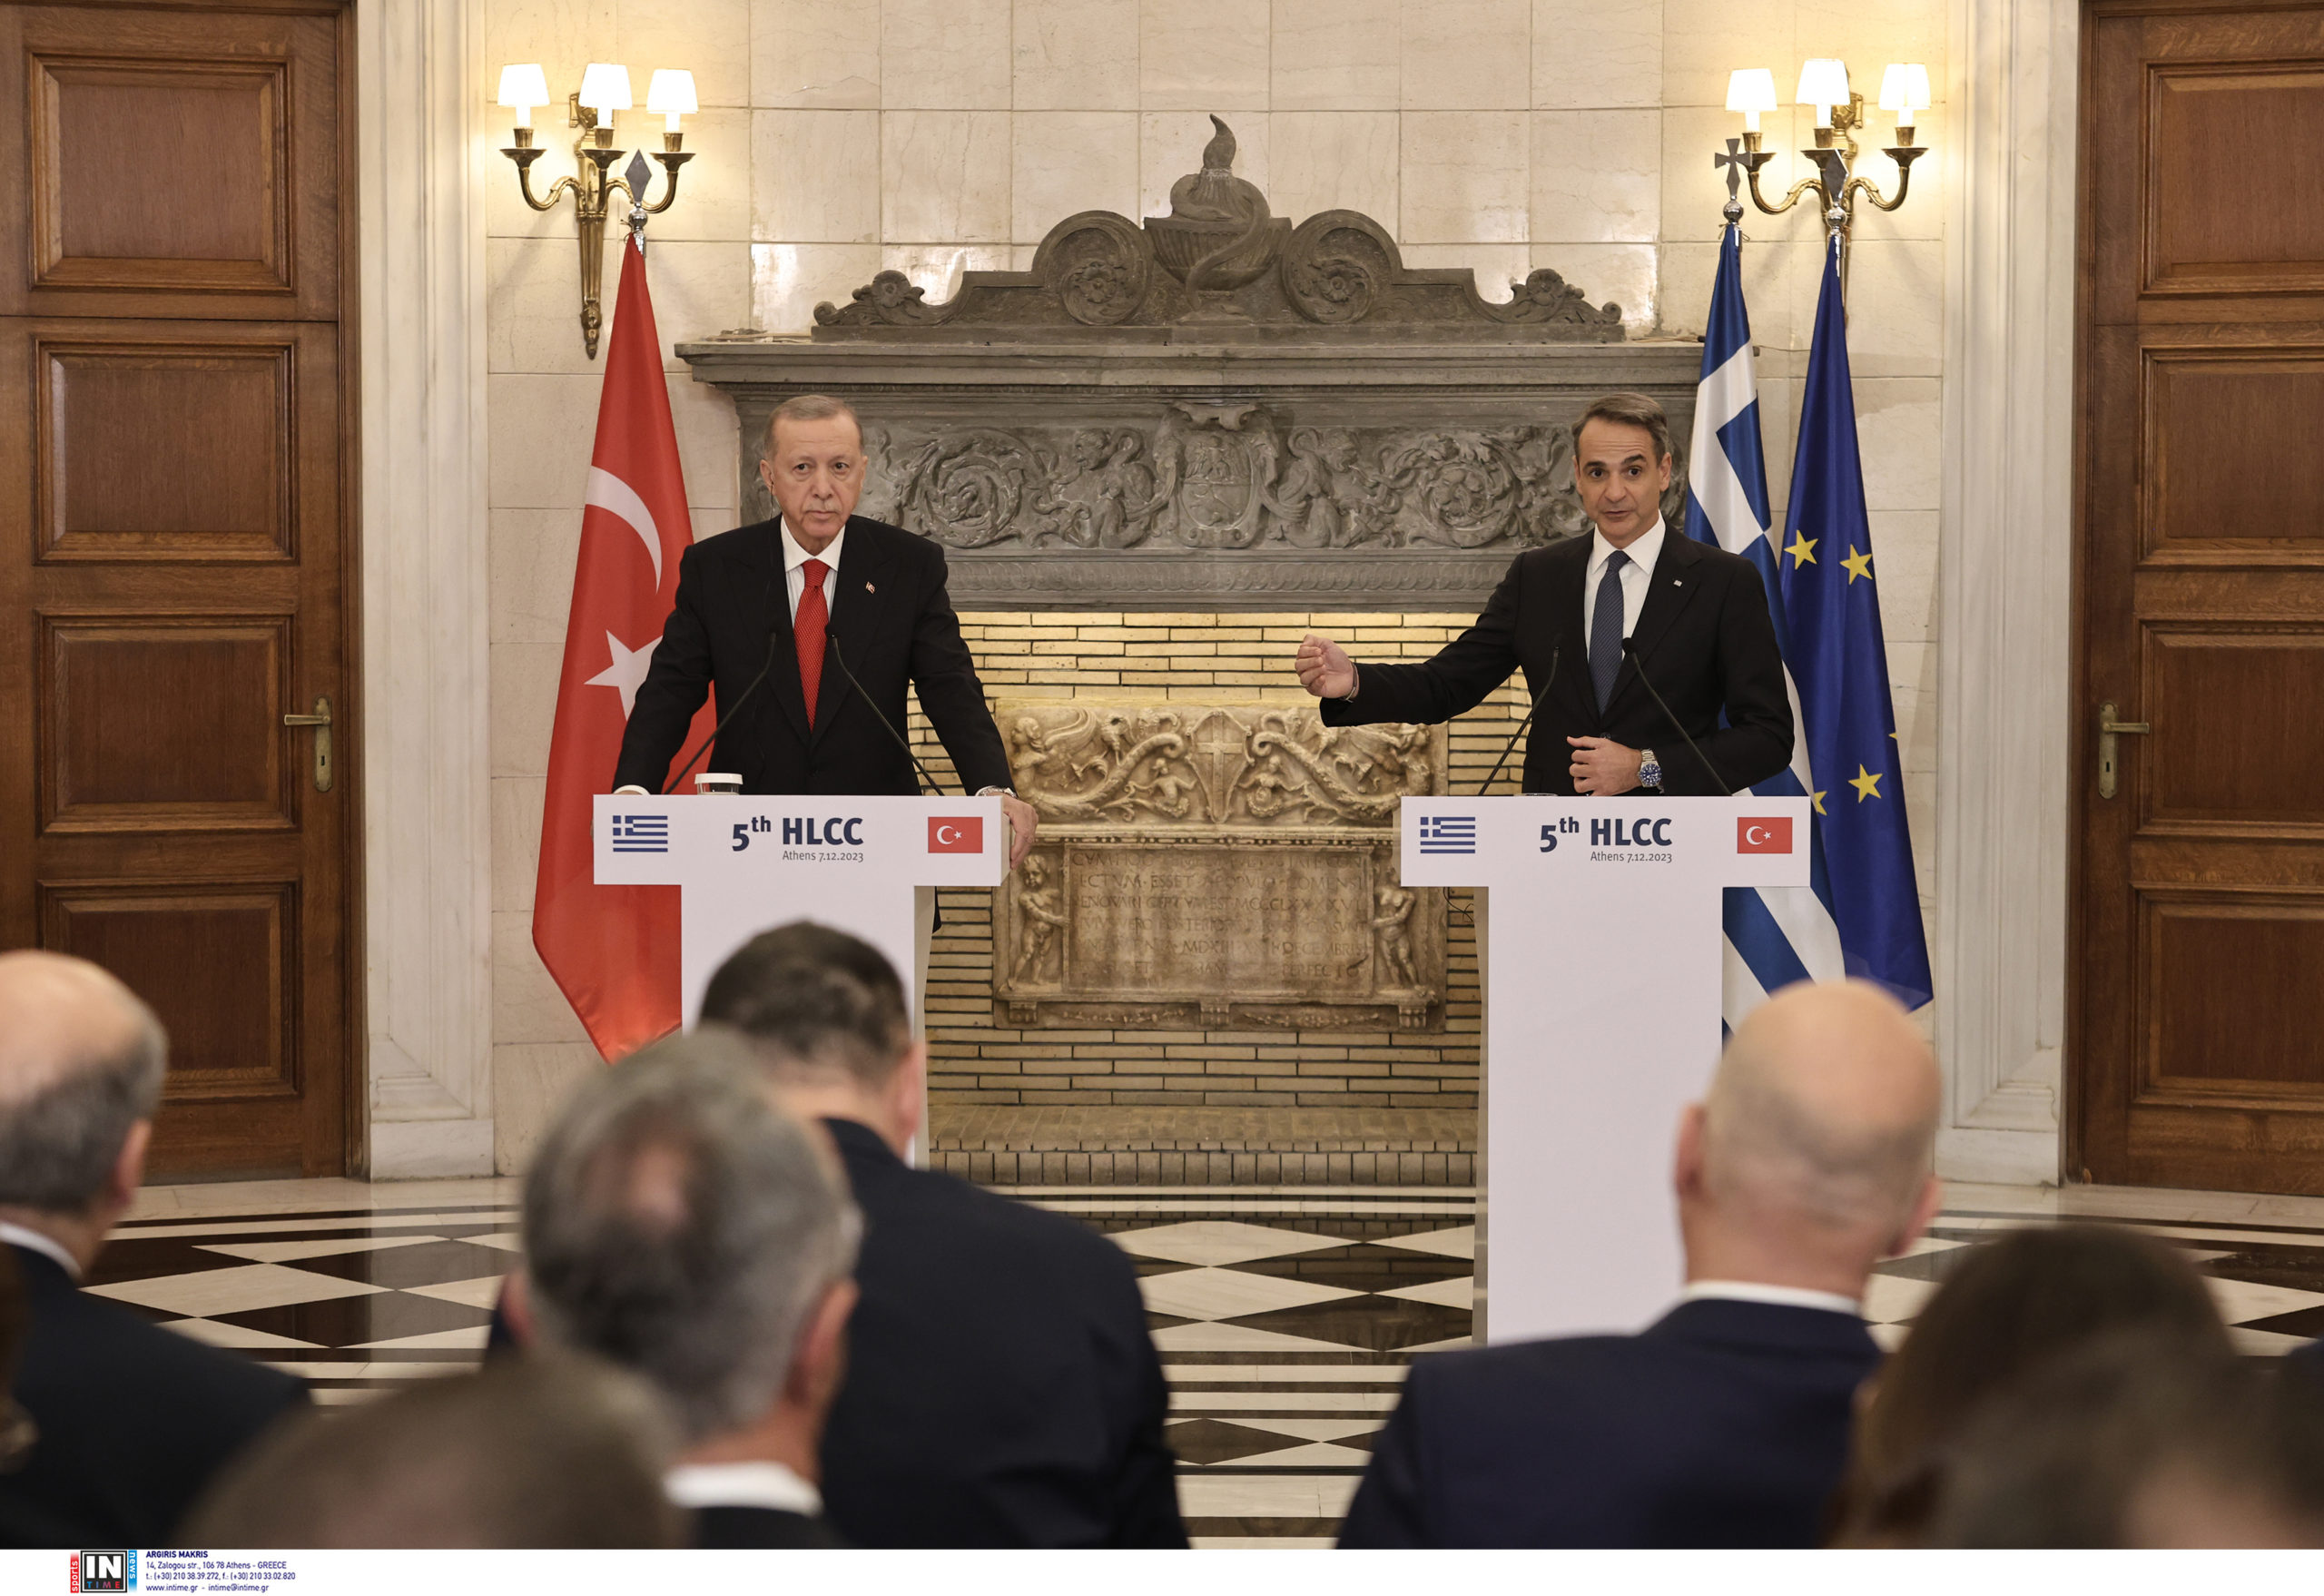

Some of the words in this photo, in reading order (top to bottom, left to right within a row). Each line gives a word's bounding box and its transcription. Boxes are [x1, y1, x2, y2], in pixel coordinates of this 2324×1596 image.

[732, 815, 772, 852] 5th
[782, 817, 864, 845] HLCC
[1539, 816, 1580, 852] 5th
[1590, 818, 1673, 846] HLCC
[782, 850, 816, 862] Athens
[818, 851, 864, 862] 7.12.2023
[1590, 851, 1624, 862] Athens
[1626, 852, 1673, 863] 7.12.2023
